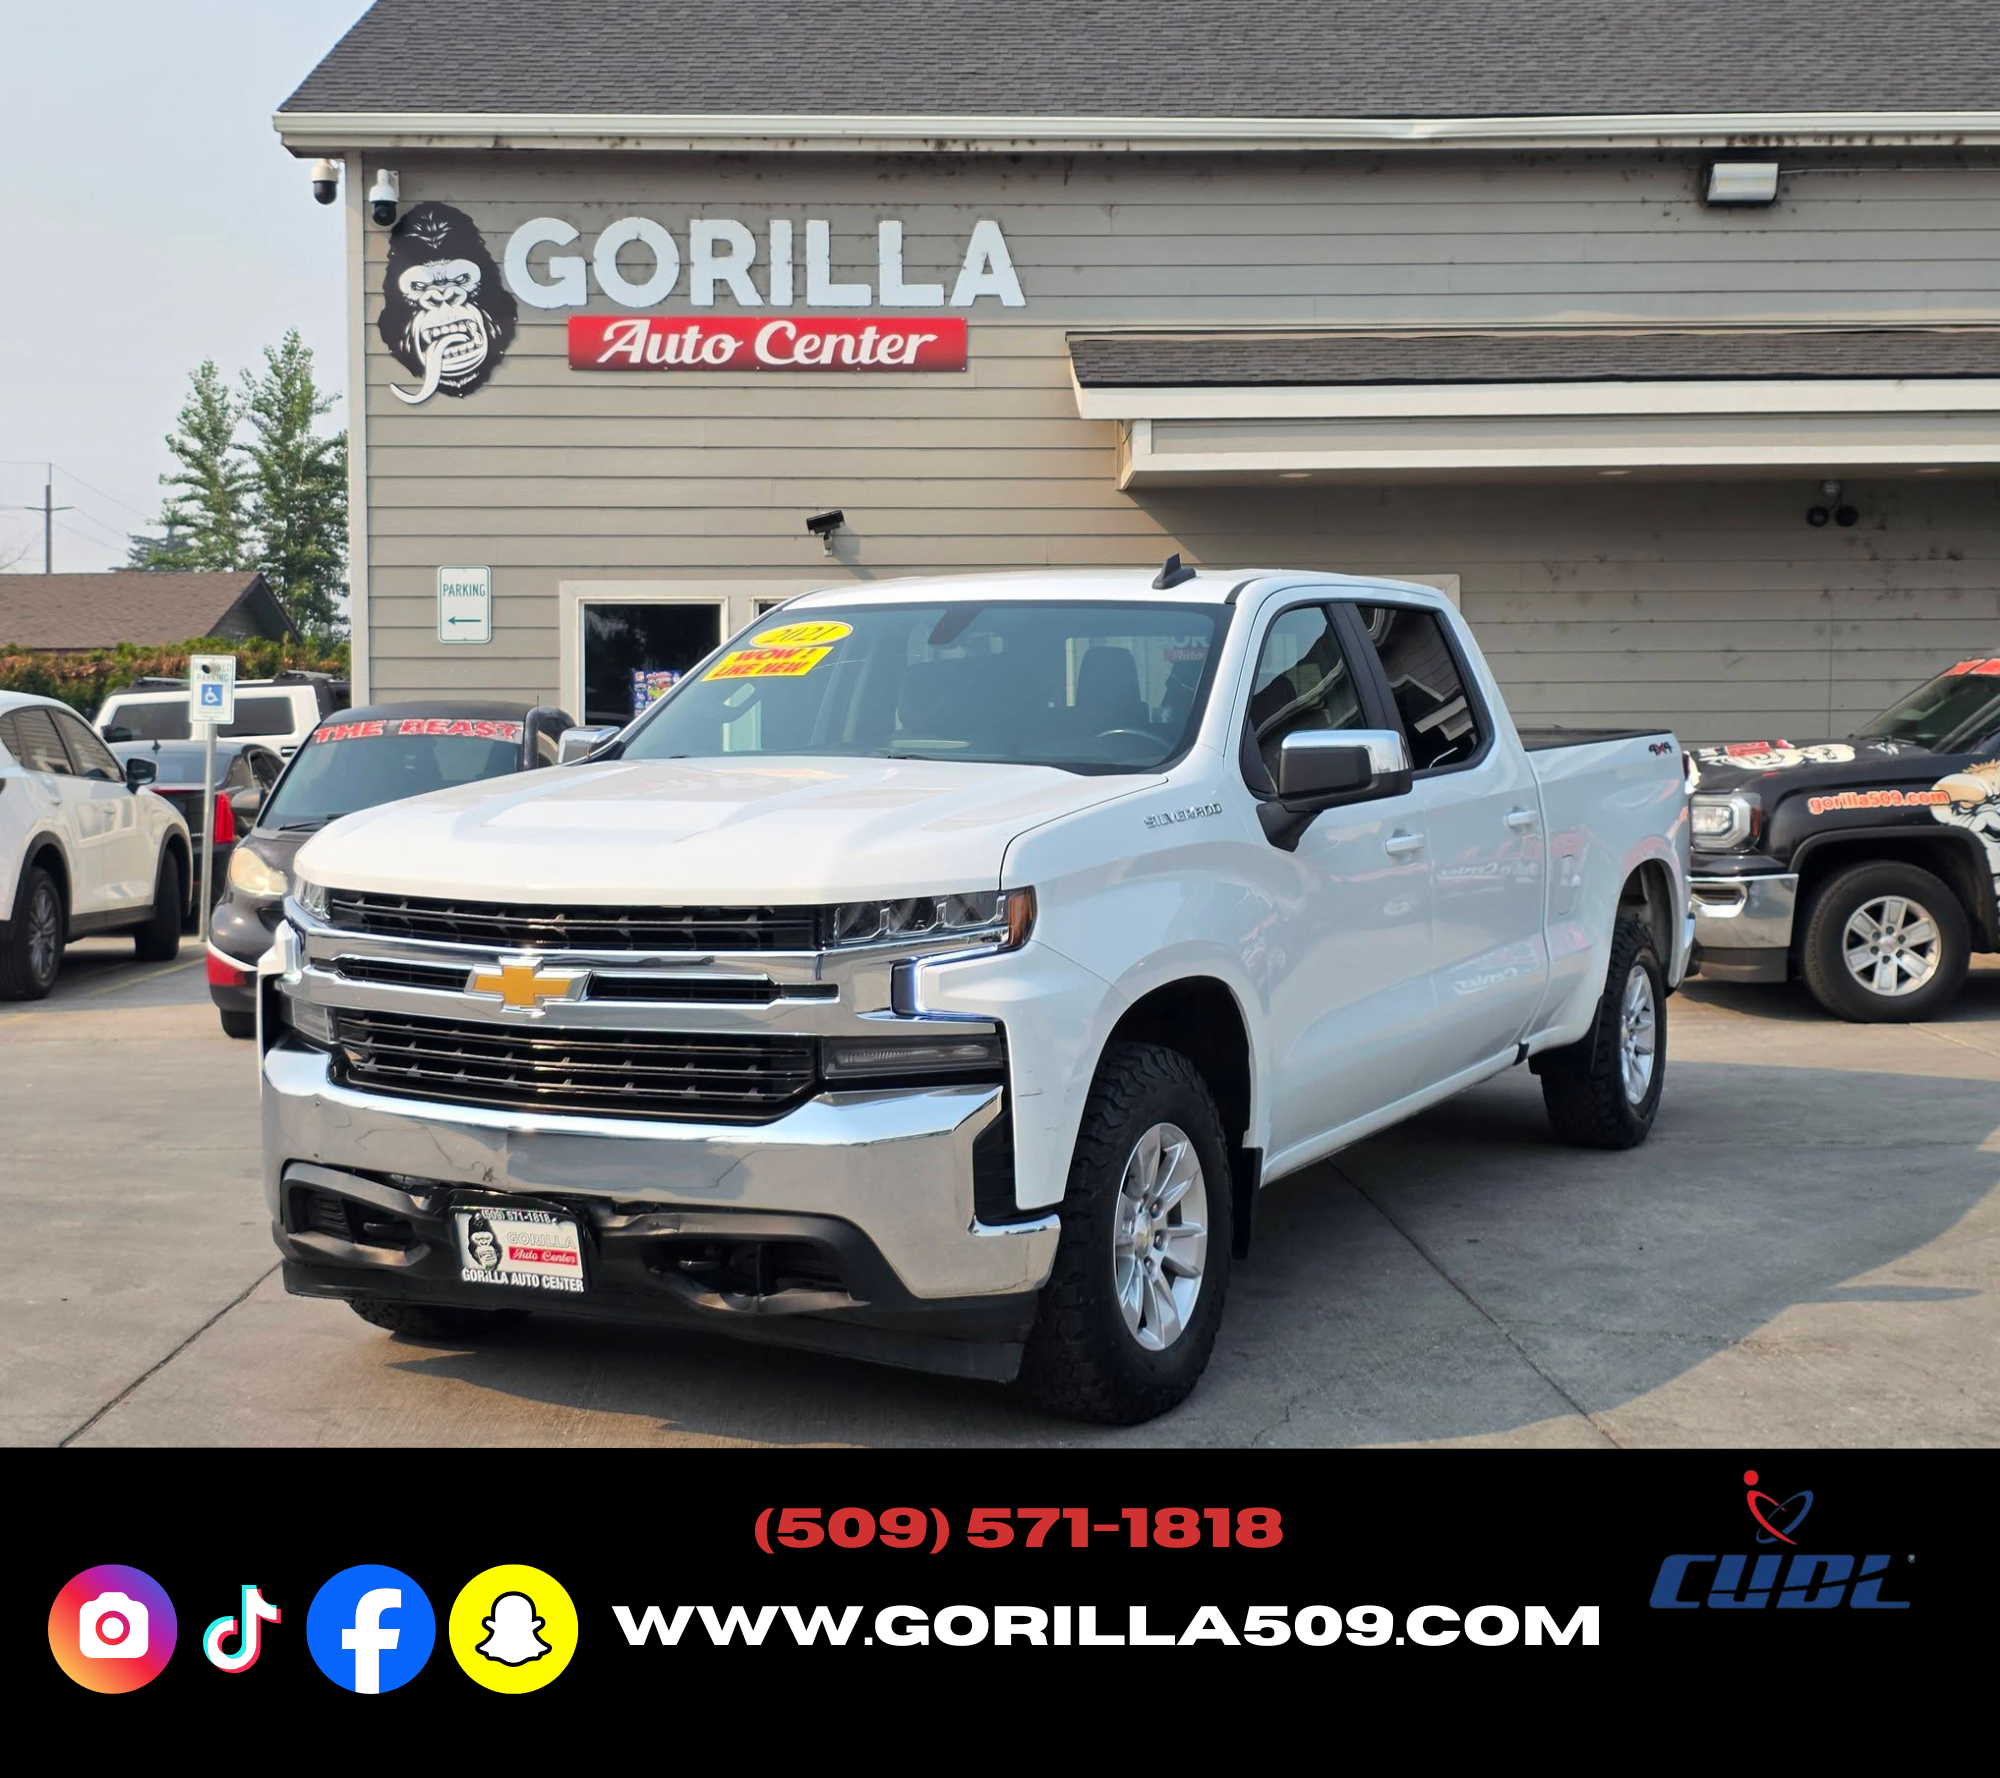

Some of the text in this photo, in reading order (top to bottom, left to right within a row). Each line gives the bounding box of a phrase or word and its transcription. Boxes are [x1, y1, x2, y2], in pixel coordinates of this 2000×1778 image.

[504, 217, 1026, 308] GORILLA
[597, 319, 938, 366] Auto Center
[443, 583, 486, 597] PARKING
[762, 626, 840, 643] 2021
[735, 648, 796, 661] WOW
[711, 661, 811, 678] LIKE NEW
[314, 718, 522, 743] THE BEAST
[1808, 790, 1950, 815] gorilla509.com
[1143, 803, 1222, 829] SILVERADO
[507, 1231, 576, 1249] GORILLA
[512, 1248, 576, 1263] Auto Center
[511, 1272, 540, 1288] AUTO
[541, 1275, 584, 1292] CENTER
